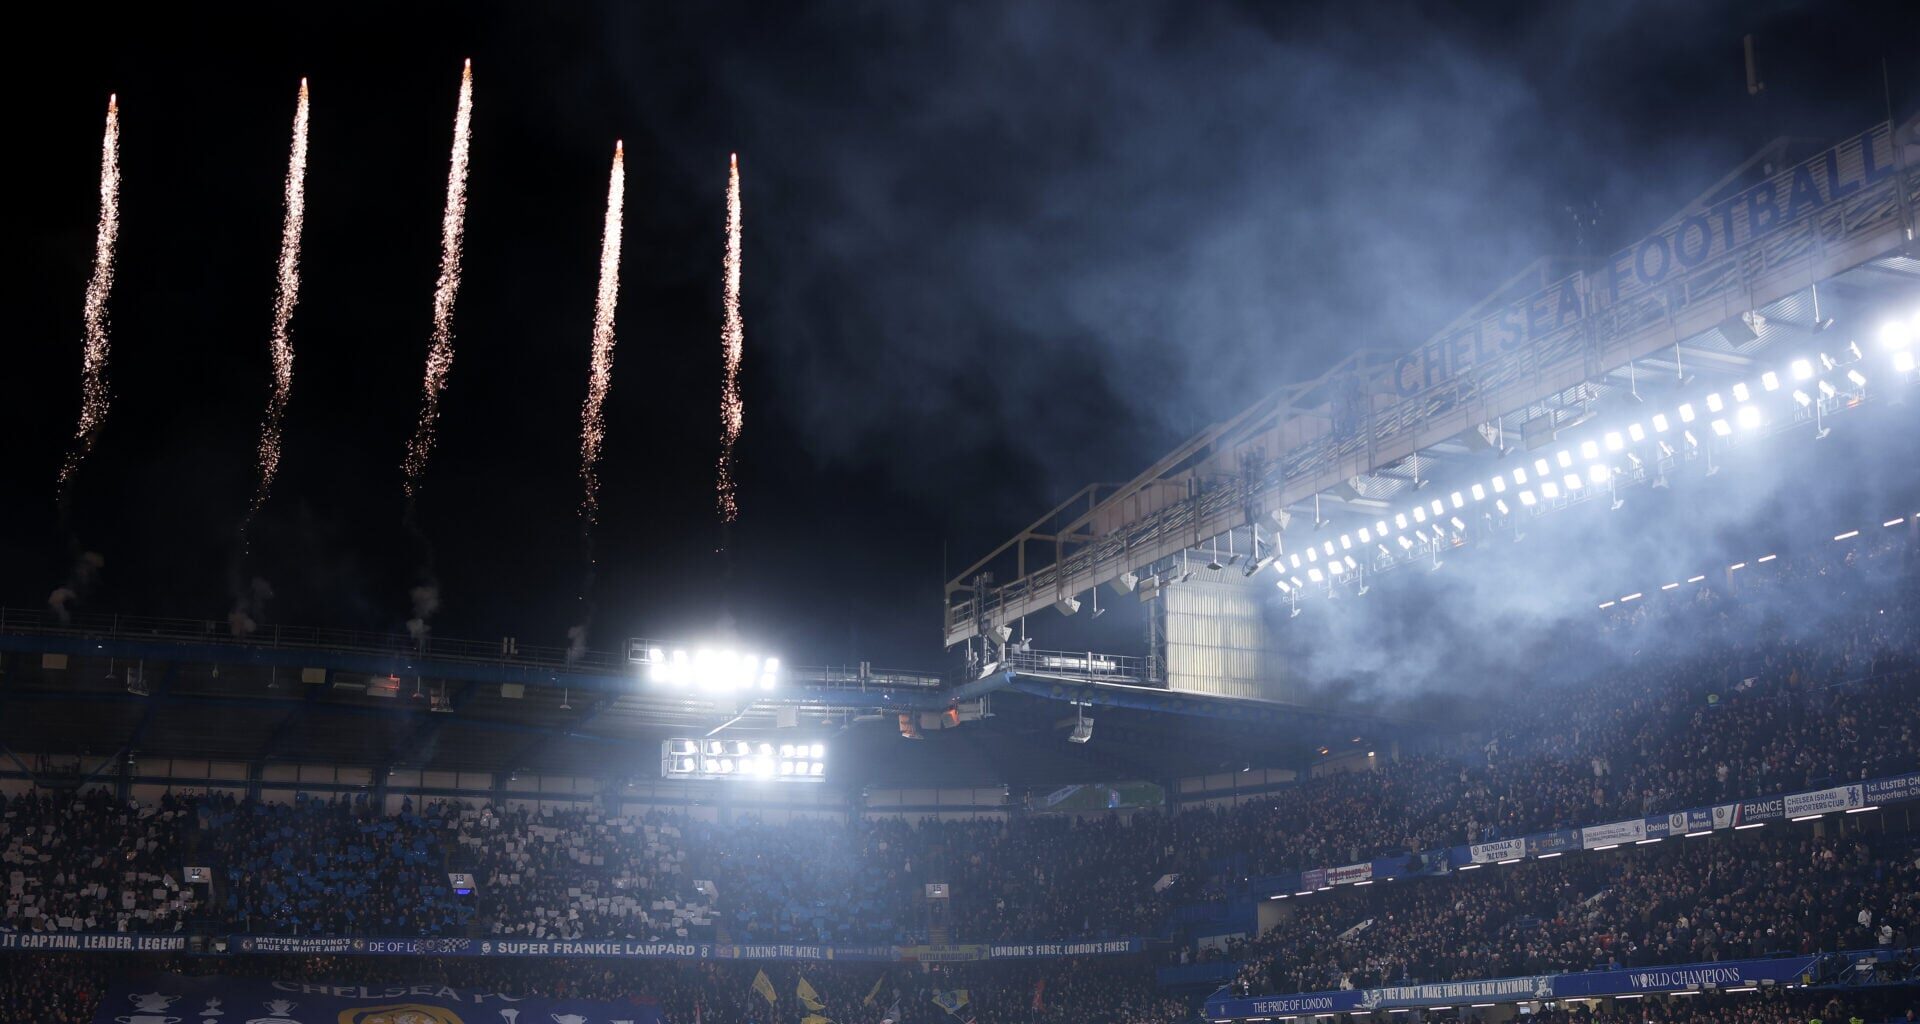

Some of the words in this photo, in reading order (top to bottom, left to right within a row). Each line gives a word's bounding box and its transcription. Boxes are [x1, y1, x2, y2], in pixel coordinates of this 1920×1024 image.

[1394, 284, 1584, 398] CHELSEA
[1609, 130, 1897, 304] FOOTBALL
[1880, 779, 1906, 791] ULSTER
[1786, 795, 1814, 806] CHELSEA
[1867, 790, 1908, 803] Supporters
[1744, 799, 1783, 816] FRANCE
[1787, 801, 1828, 814] SUPPORTERS
[1828, 799, 1845, 808] CLUB
[1693, 811, 1706, 820] West
[1745, 813, 1771, 822] SUPPORTERS
[1646, 822, 1669, 833] Chelsea
[1689, 820, 1711, 830] Midlands
[1481, 840, 1512, 853] DUNDALK
[2, 934, 17, 947] JT
[20, 934, 81, 949] CAPTAIN,
[84, 935, 135, 951] LEADER,
[138, 937, 185, 950] LEGEND
[255, 937, 300, 946] MATTHEW
[302, 937, 351, 946] HARDING'S
[257, 943, 281, 951] BLUE
[283, 944, 289, 952] &
[387, 942, 403, 952] OF
[497, 942, 549, 954] SUPER
[553, 942, 621, 955] FRANKIE
[626, 943, 696, 956] LAMPARD
[701, 946, 708, 958] 8
[745, 945, 777, 958] TAKING
[779, 945, 793, 957] THE
[796, 946, 820, 959] MIKEL
[990, 945, 1034, 957] LONDON'S
[1036, 944, 1063, 956] FIRST,
[1064, 942, 1102, 955] LONDON'S
[1104, 941, 1130, 953] FINEST
[1630, 972, 1670, 988] WORLD
[1671, 967, 1740, 986] CHAMPIONS
[271, 980, 463, 1002] CHELSEA
[1383, 988, 1399, 1000] THEY
[1400, 987, 1420, 1000] DON'T
[1422, 986, 1442, 999] MAKE
[1443, 984, 1463, 998] THEM
[1464, 983, 1480, 997] LIKE
[1481, 982, 1495, 996] RAY
[1496, 979, 1533, 995] ANYMORE
[1254, 1002, 1267, 1013] THE
[1268, 1000, 1288, 1012] PRIDE
[1289, 999, 1299, 1011] OF
[1301, 997, 1333, 1010] LONDON
